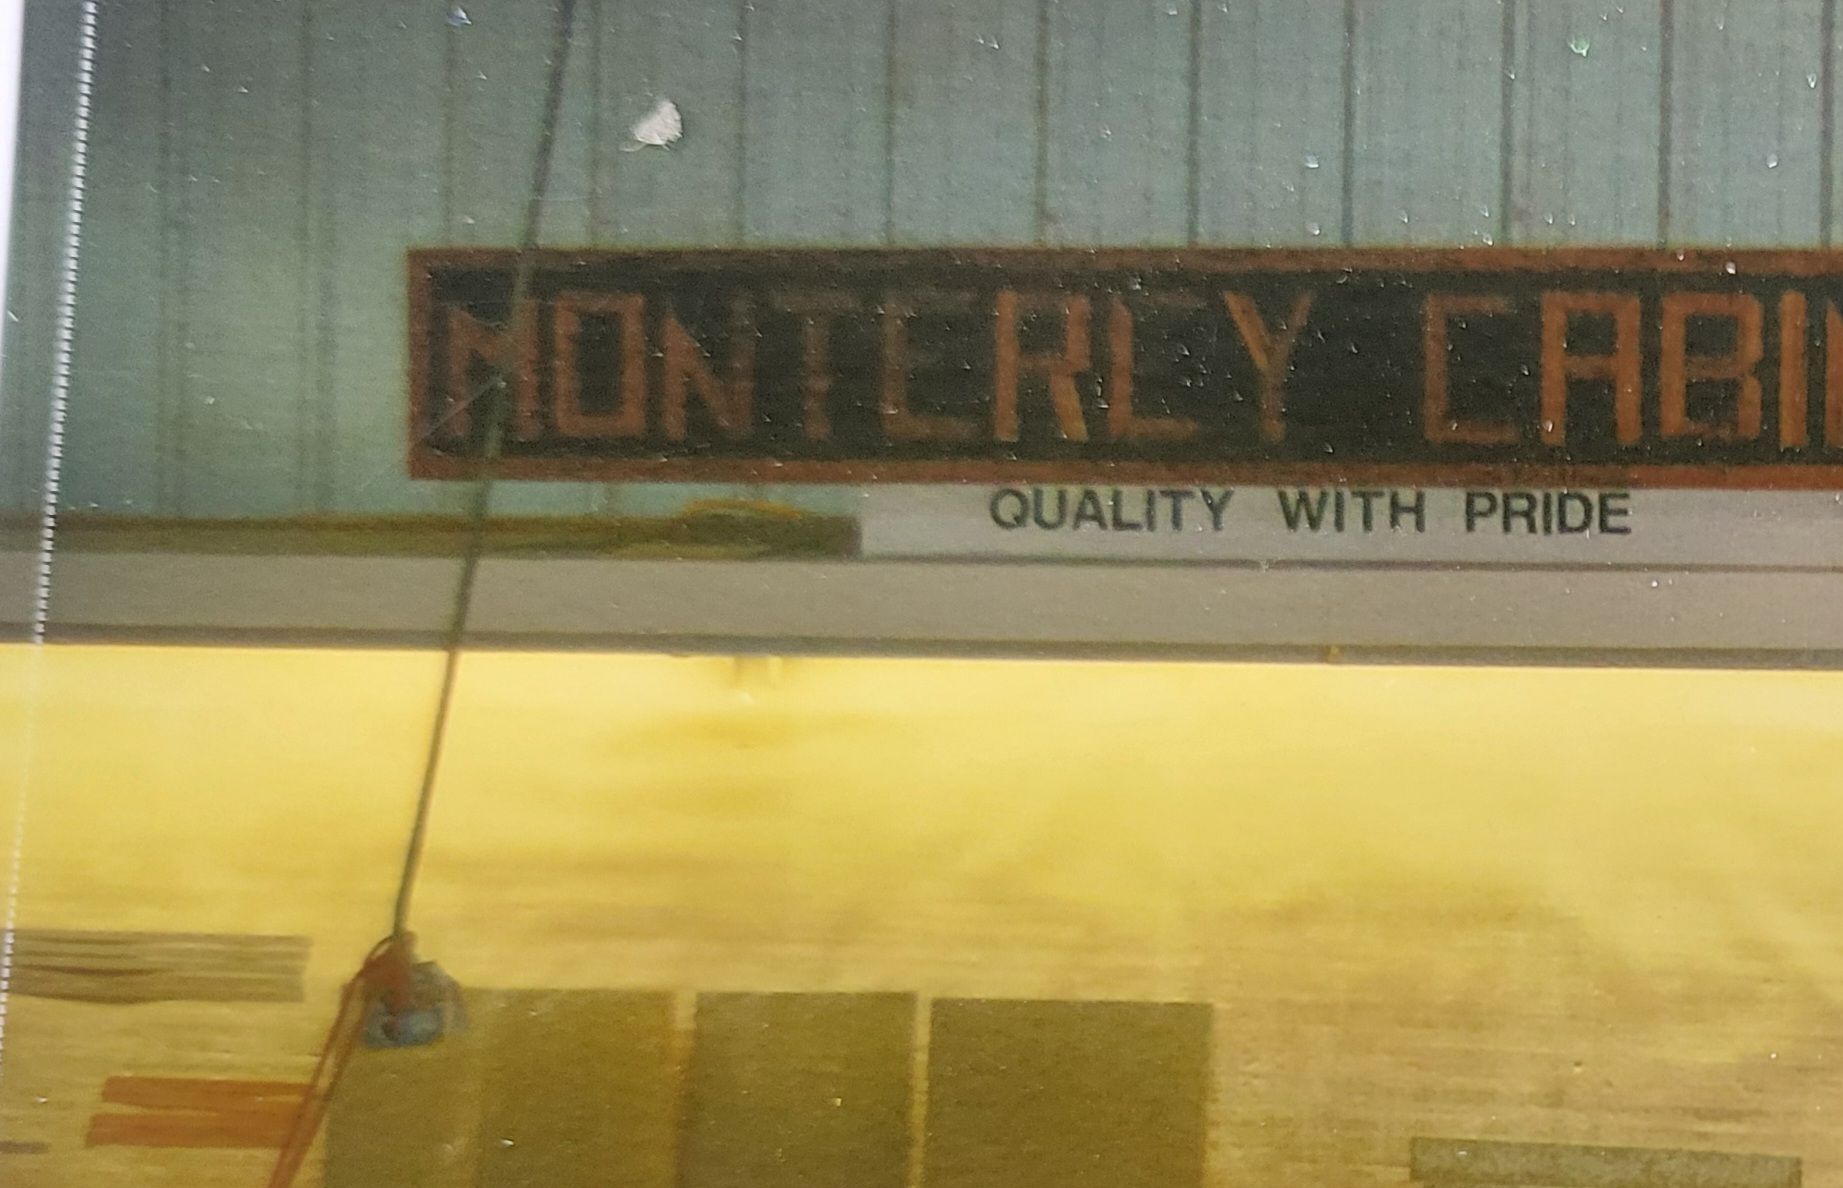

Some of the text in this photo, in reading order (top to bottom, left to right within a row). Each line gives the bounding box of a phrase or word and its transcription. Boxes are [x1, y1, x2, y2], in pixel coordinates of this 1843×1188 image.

[989, 488, 1633, 535] QUALITY WITH PRIDE
